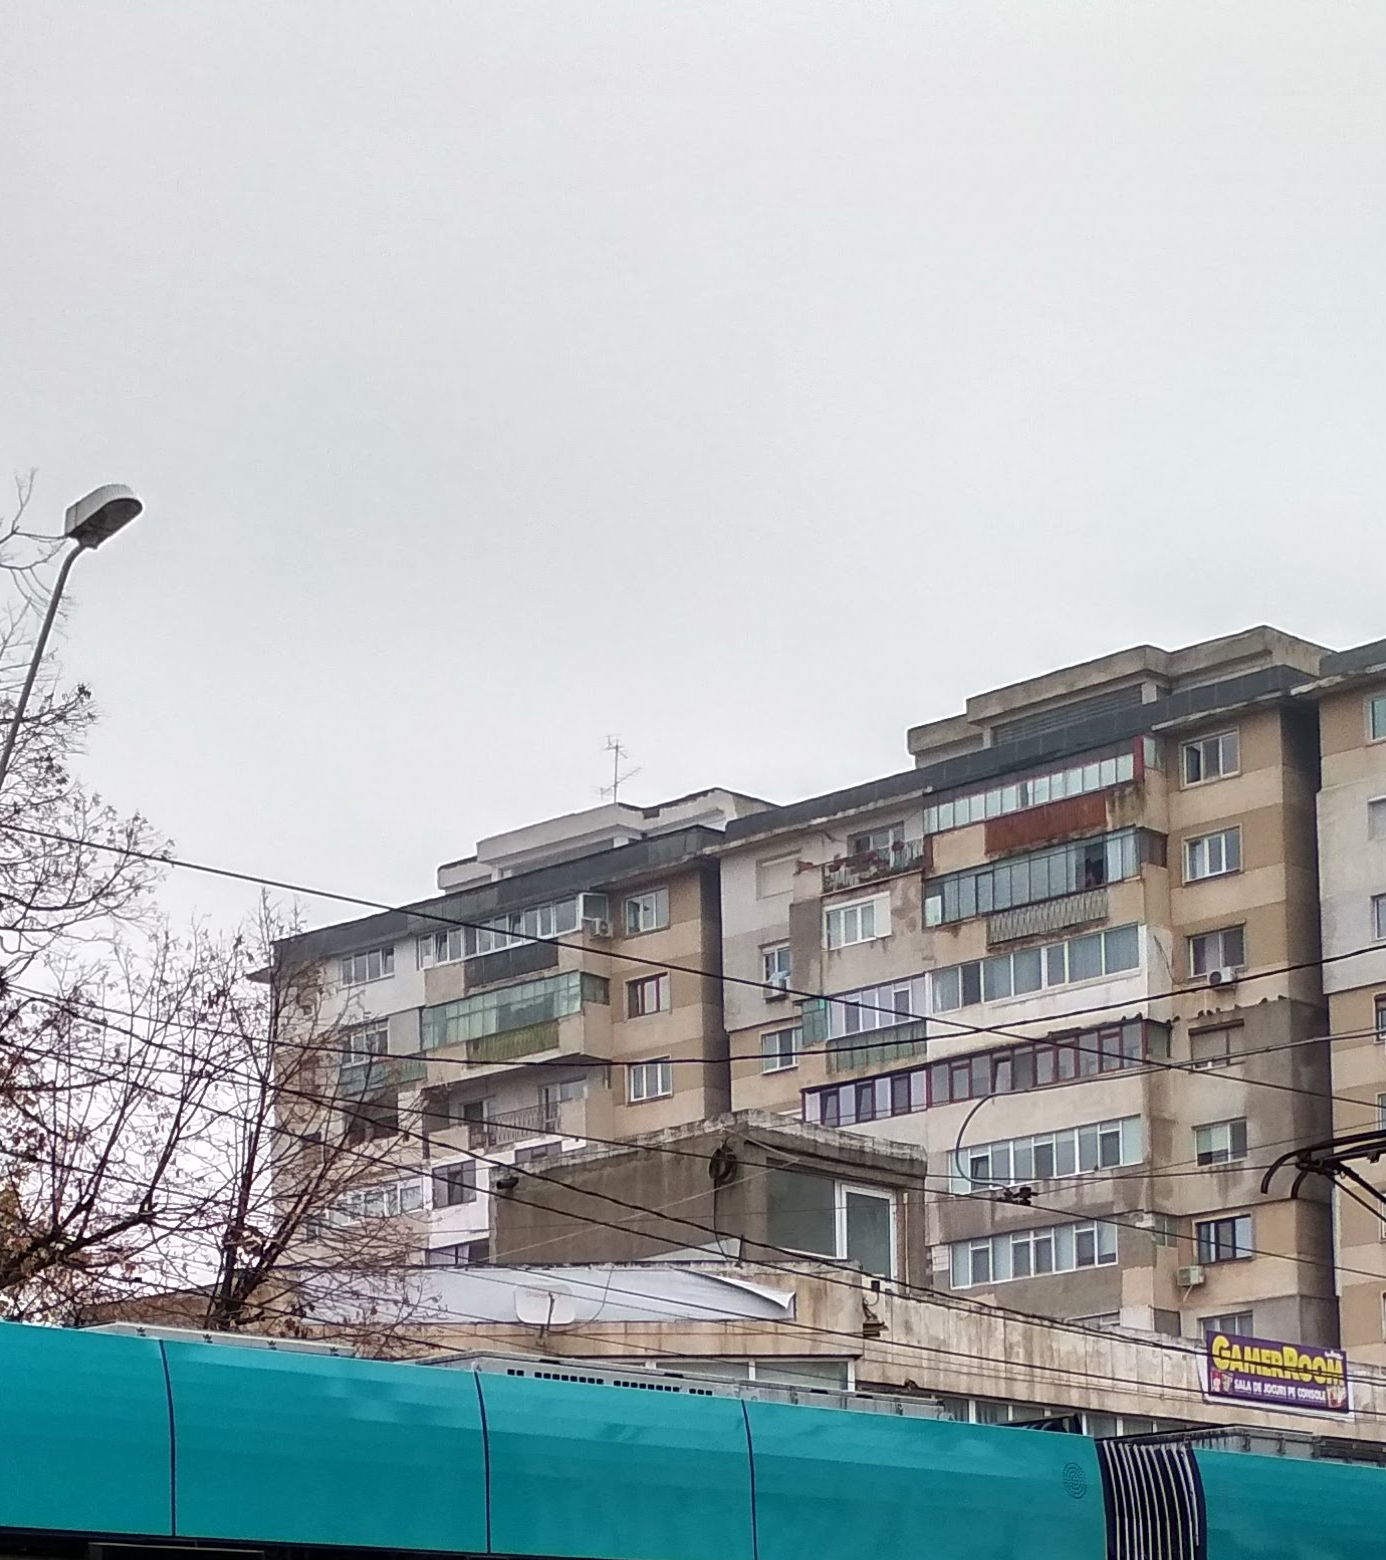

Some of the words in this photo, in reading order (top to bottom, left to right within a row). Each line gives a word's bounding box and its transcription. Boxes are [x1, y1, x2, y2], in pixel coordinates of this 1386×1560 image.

[1233, 1378, 1252, 1391] SALA
[1252, 1381, 1263, 1394] DE
[1263, 1383, 1287, 1397] JOCURI
[1287, 1385, 1297, 1400] PE
[1297, 1386, 1327, 1402] CONSOLE
